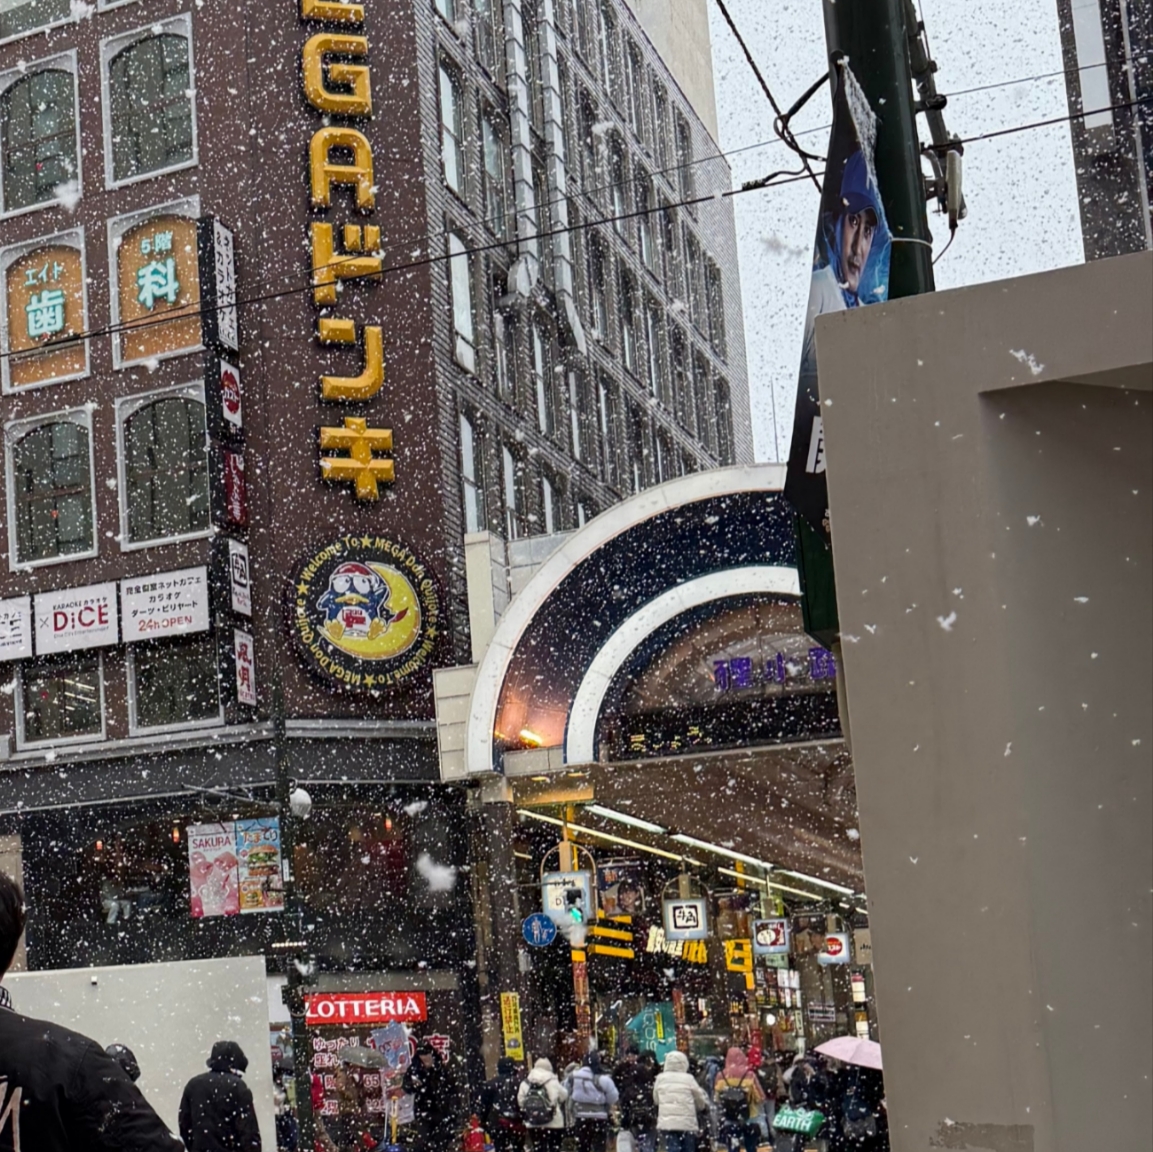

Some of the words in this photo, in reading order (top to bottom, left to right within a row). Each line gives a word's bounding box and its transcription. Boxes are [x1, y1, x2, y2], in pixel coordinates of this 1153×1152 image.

[140, 231, 174, 254] 5階
[24, 261, 64, 286] エイト
[300, 541, 343, 582] Welcome
[343, 535, 359, 548] To
[374, 536, 407, 562] MEGA
[53, 600, 82, 611] KARAOKE
[149, 591, 181, 603] カラオケ
[161, 615, 193, 628] OPEN
[310, 643, 329, 671] Don
[327, 663, 362, 685] MEGA
[377, 673, 394, 685] To
[192, 835, 231, 849] SAKURA
[305, 997, 420, 1018] LOTTERIA
[772, 1112, 813, 1132] EARTH
